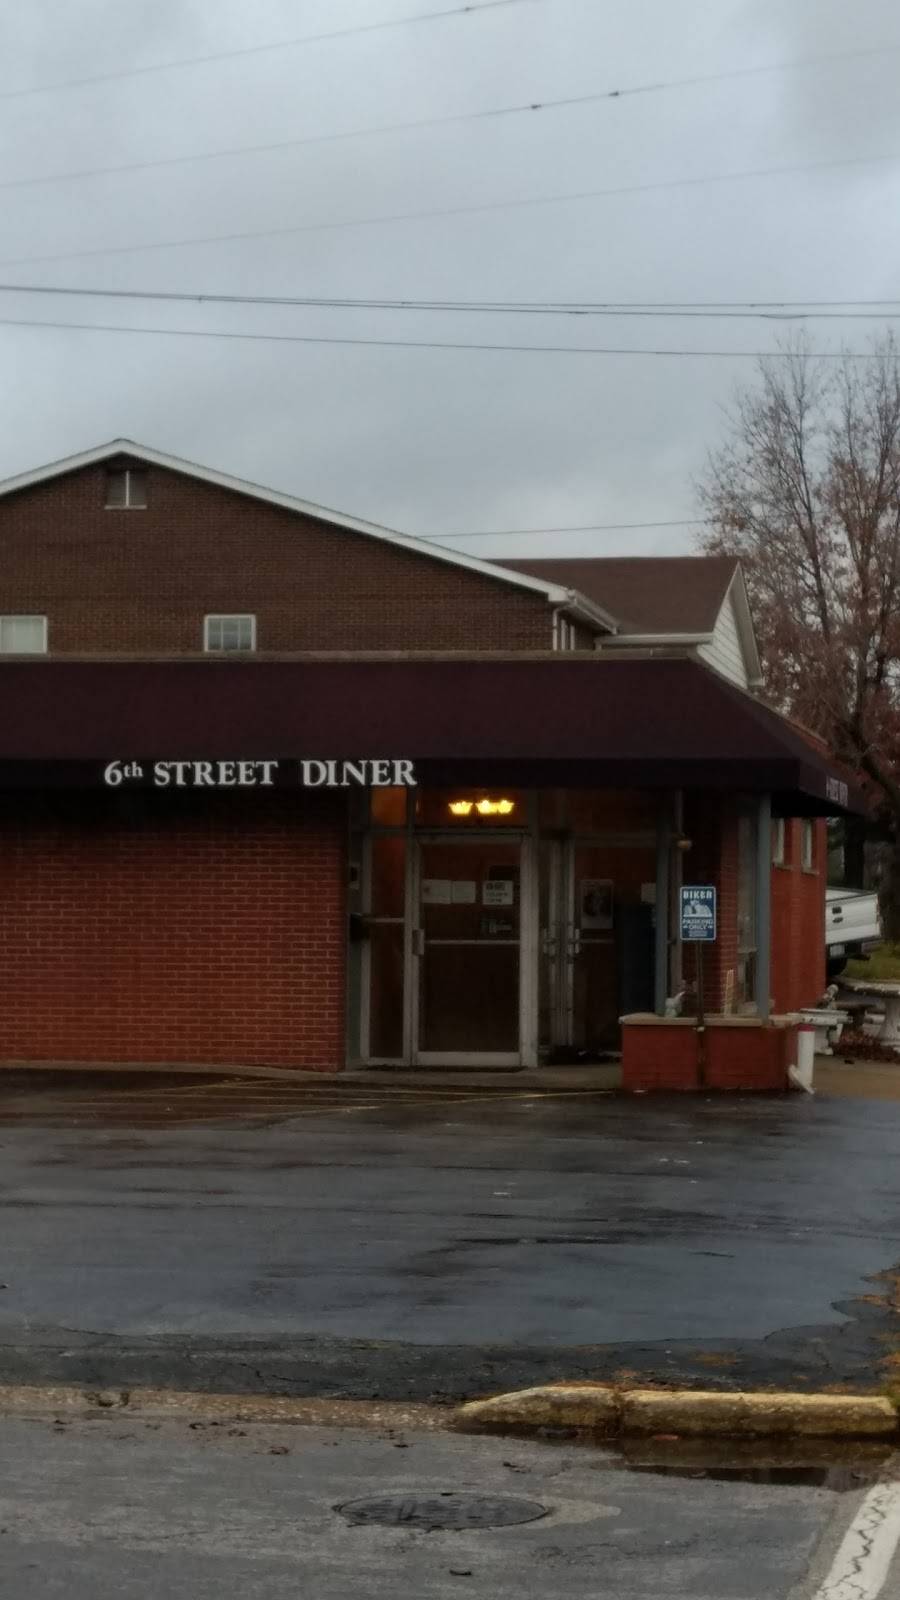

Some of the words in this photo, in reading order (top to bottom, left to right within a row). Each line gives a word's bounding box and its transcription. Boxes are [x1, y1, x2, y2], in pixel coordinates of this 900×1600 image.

[103, 760, 143, 786] 6th
[153, 760, 279, 786] STREET
[300, 759, 417, 786] DINER
[683, 890, 712, 899] BIKER
